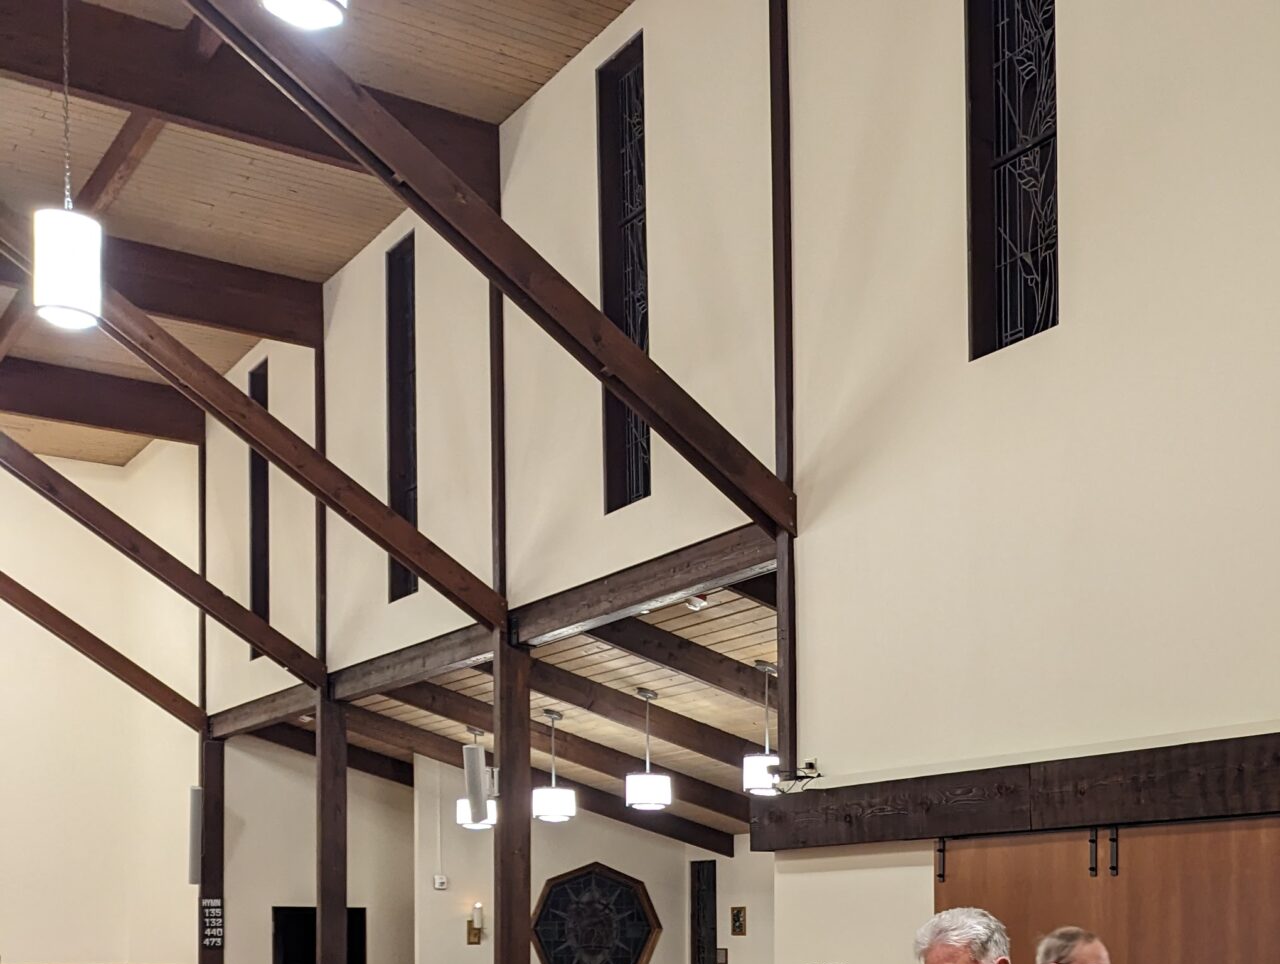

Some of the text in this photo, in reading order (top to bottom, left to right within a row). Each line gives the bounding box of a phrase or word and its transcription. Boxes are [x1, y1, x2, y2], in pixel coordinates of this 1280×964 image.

[202, 899, 221, 907] HYMN
[204, 908, 222, 917] 135
[204, 918, 222, 927] 132
[204, 928, 223, 937] 440
[203, 937, 222, 946] 473
